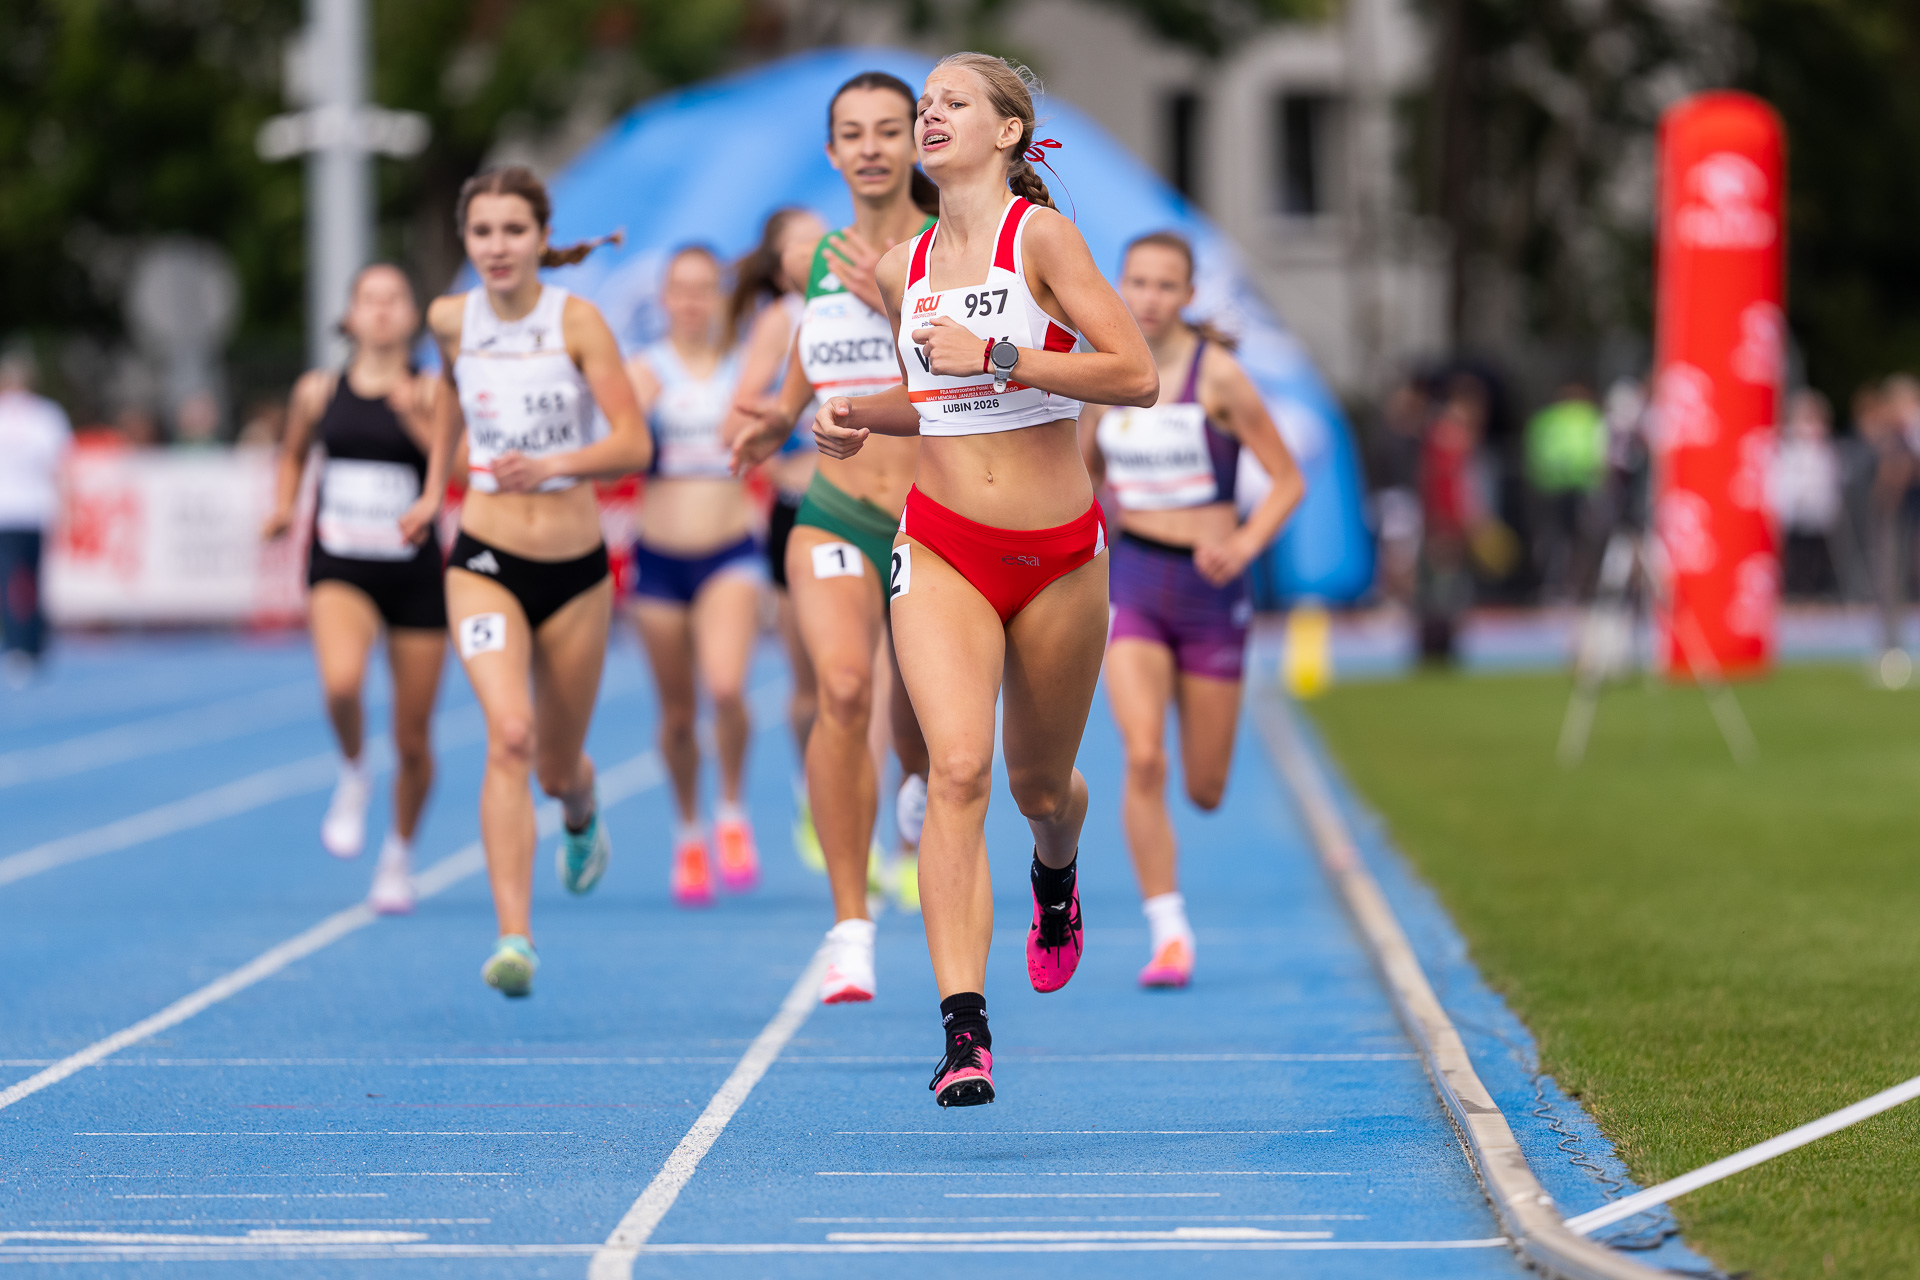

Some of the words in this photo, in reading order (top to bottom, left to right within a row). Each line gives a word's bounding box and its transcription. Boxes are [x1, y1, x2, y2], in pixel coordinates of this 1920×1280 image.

[965, 289, 1009, 318] 957
[943, 402, 971, 413] LUBIN
[974, 399, 1000, 410] 2026
[829, 549, 846, 569] 1
[891, 552, 902, 594] 2
[472, 617, 493, 648] 5
